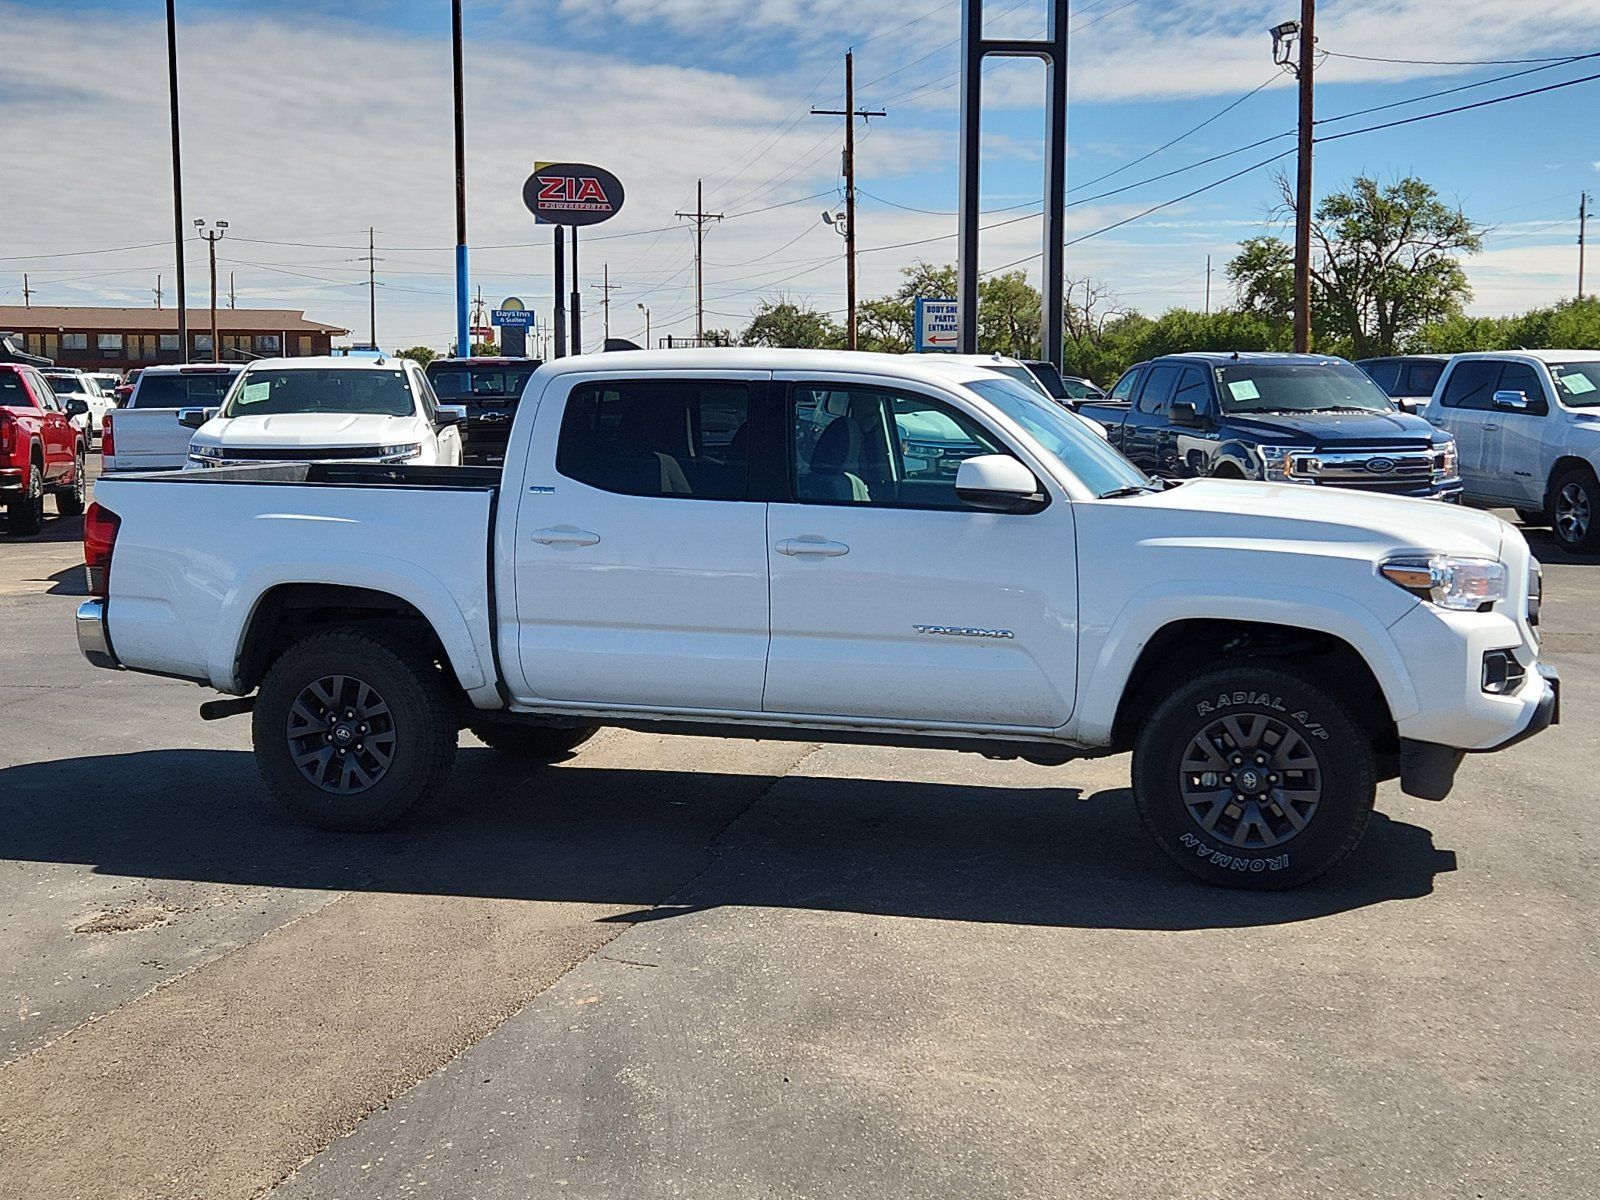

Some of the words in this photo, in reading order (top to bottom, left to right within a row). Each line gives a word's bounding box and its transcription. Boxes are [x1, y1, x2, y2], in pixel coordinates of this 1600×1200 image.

[537, 176, 609, 202] ZIA
[544, 202, 606, 210] POWERSPORTS
[926, 305, 944, 314] BODY
[945, 305, 958, 314] SHO
[934, 315, 955, 323] PARTS
[928, 324, 958, 332] ENTRANC
[912, 624, 1014, 639] TACOMA
[1196, 691, 1287, 717] RADIAL
[1291, 710, 1330, 741] A/P
[1179, 832, 1290, 872] IRONMAN
